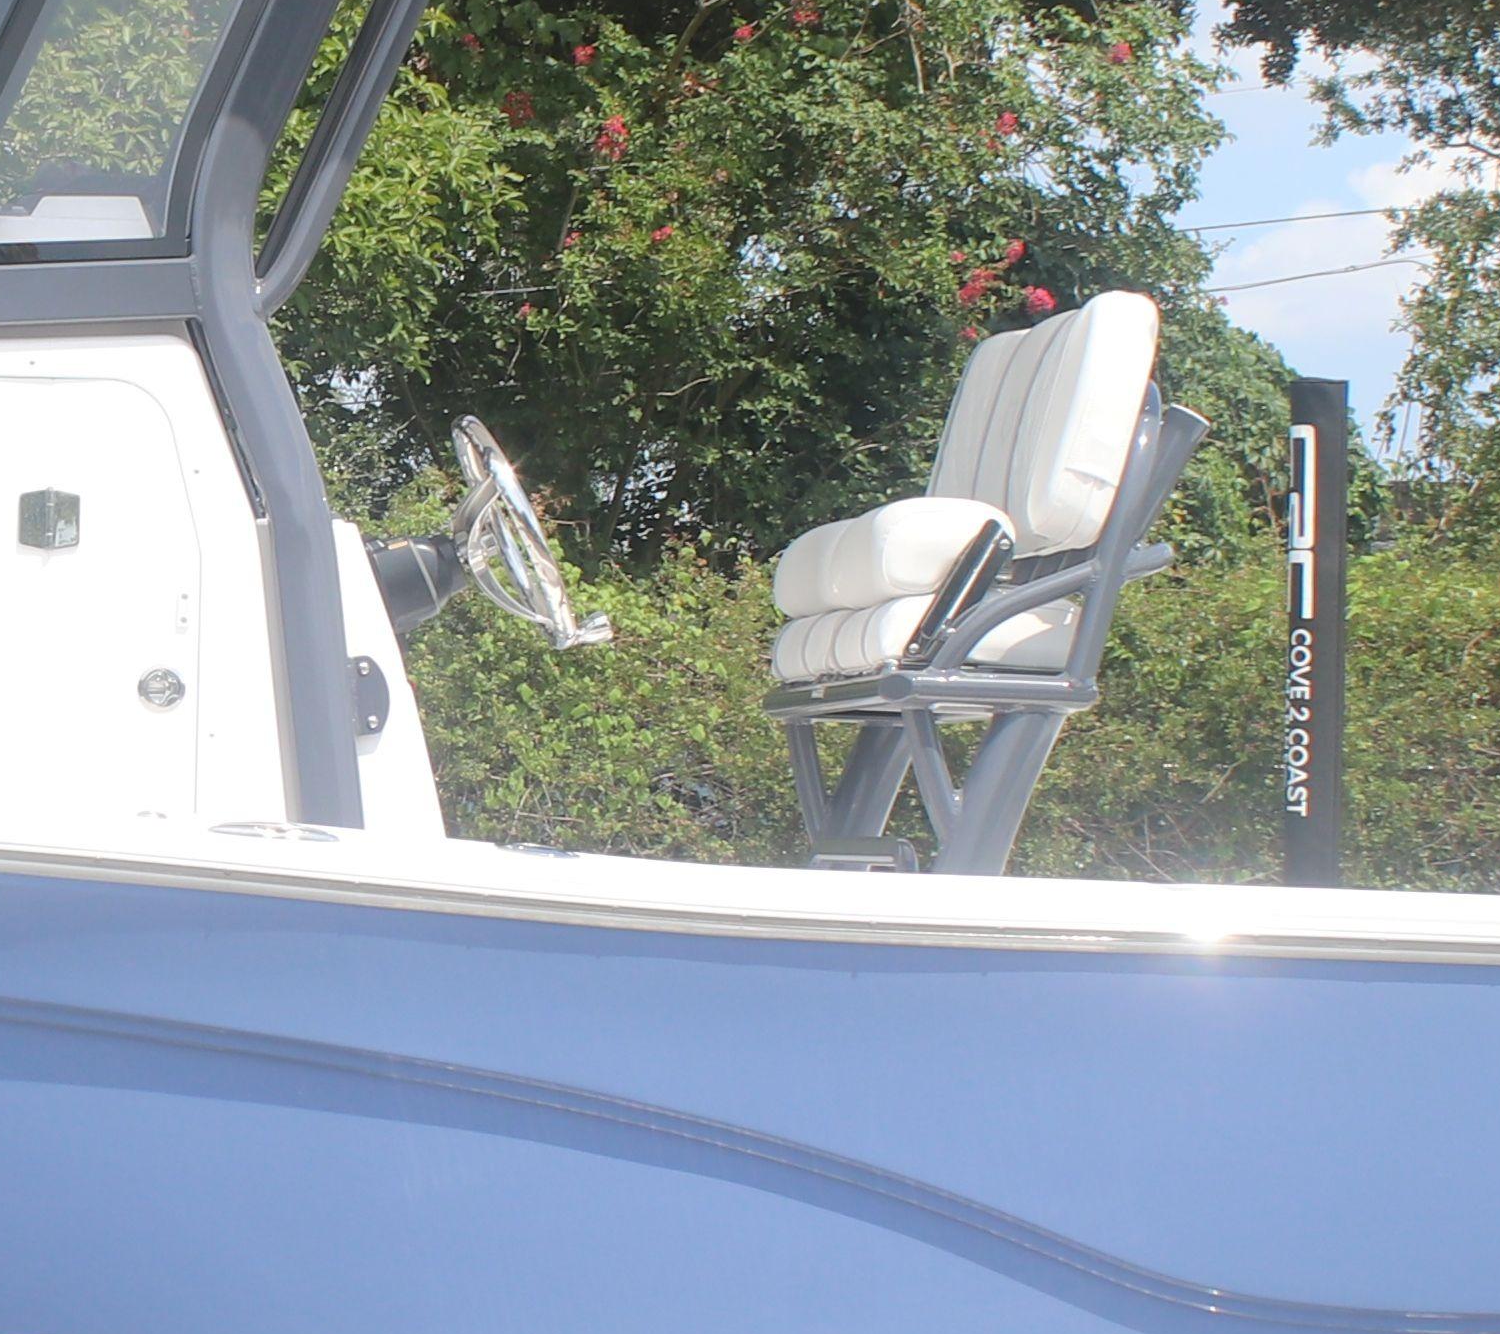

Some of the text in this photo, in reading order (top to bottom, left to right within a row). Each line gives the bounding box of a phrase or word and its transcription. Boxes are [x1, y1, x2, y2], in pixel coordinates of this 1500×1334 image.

[1286, 628, 1312, 818] COVE 2 COAST
